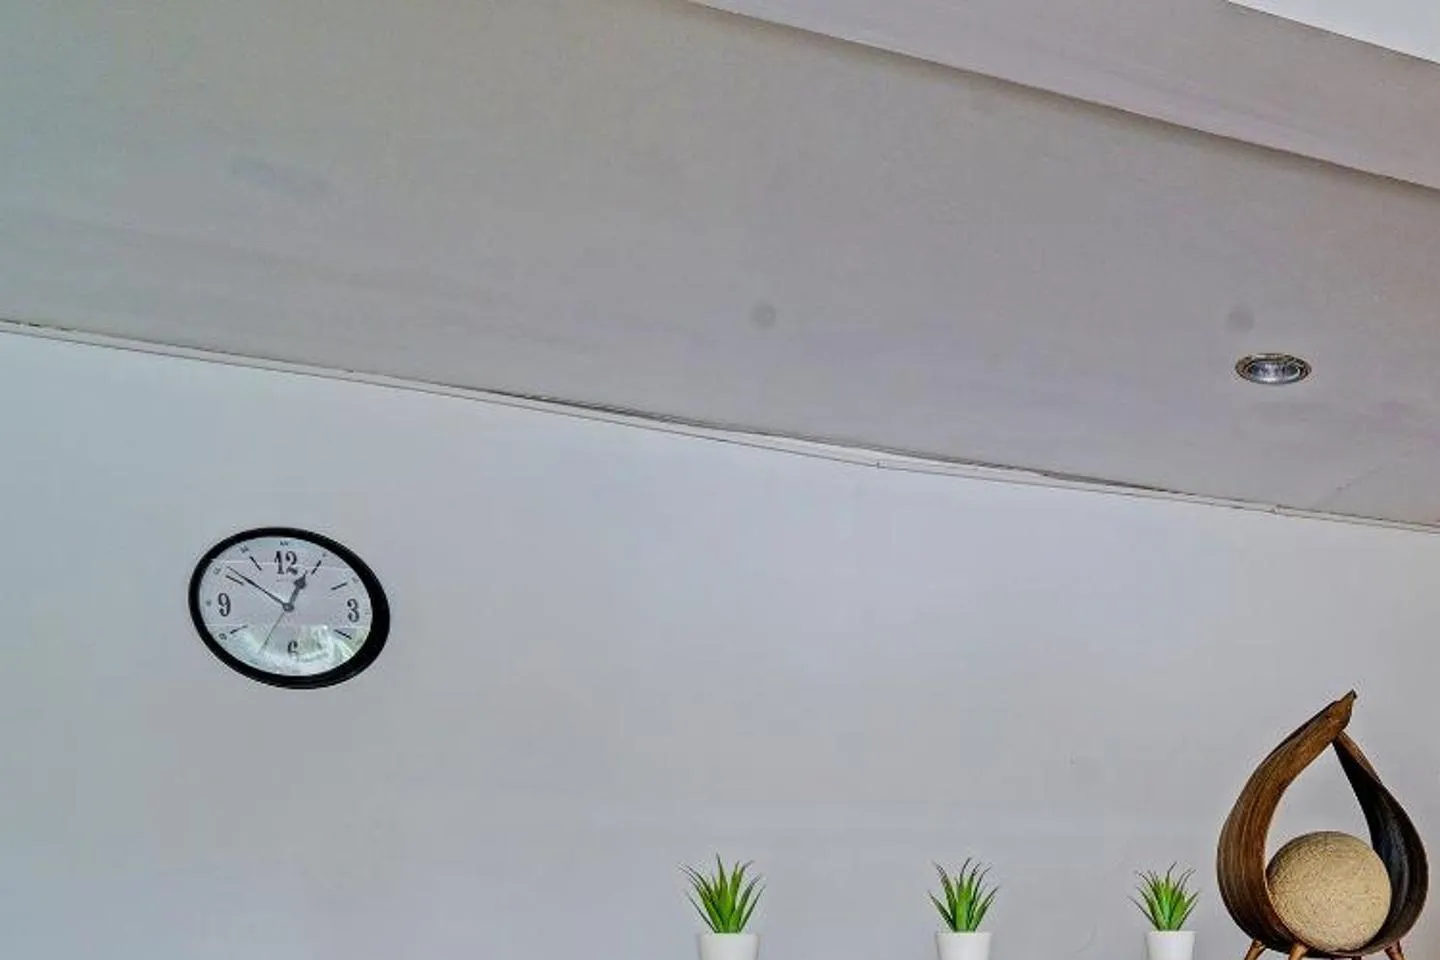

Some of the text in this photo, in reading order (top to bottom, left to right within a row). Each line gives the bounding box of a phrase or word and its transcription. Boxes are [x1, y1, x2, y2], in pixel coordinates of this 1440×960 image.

[274, 550, 299, 575] 12
[218, 592, 232, 617] 9
[346, 598, 360, 623] 3
